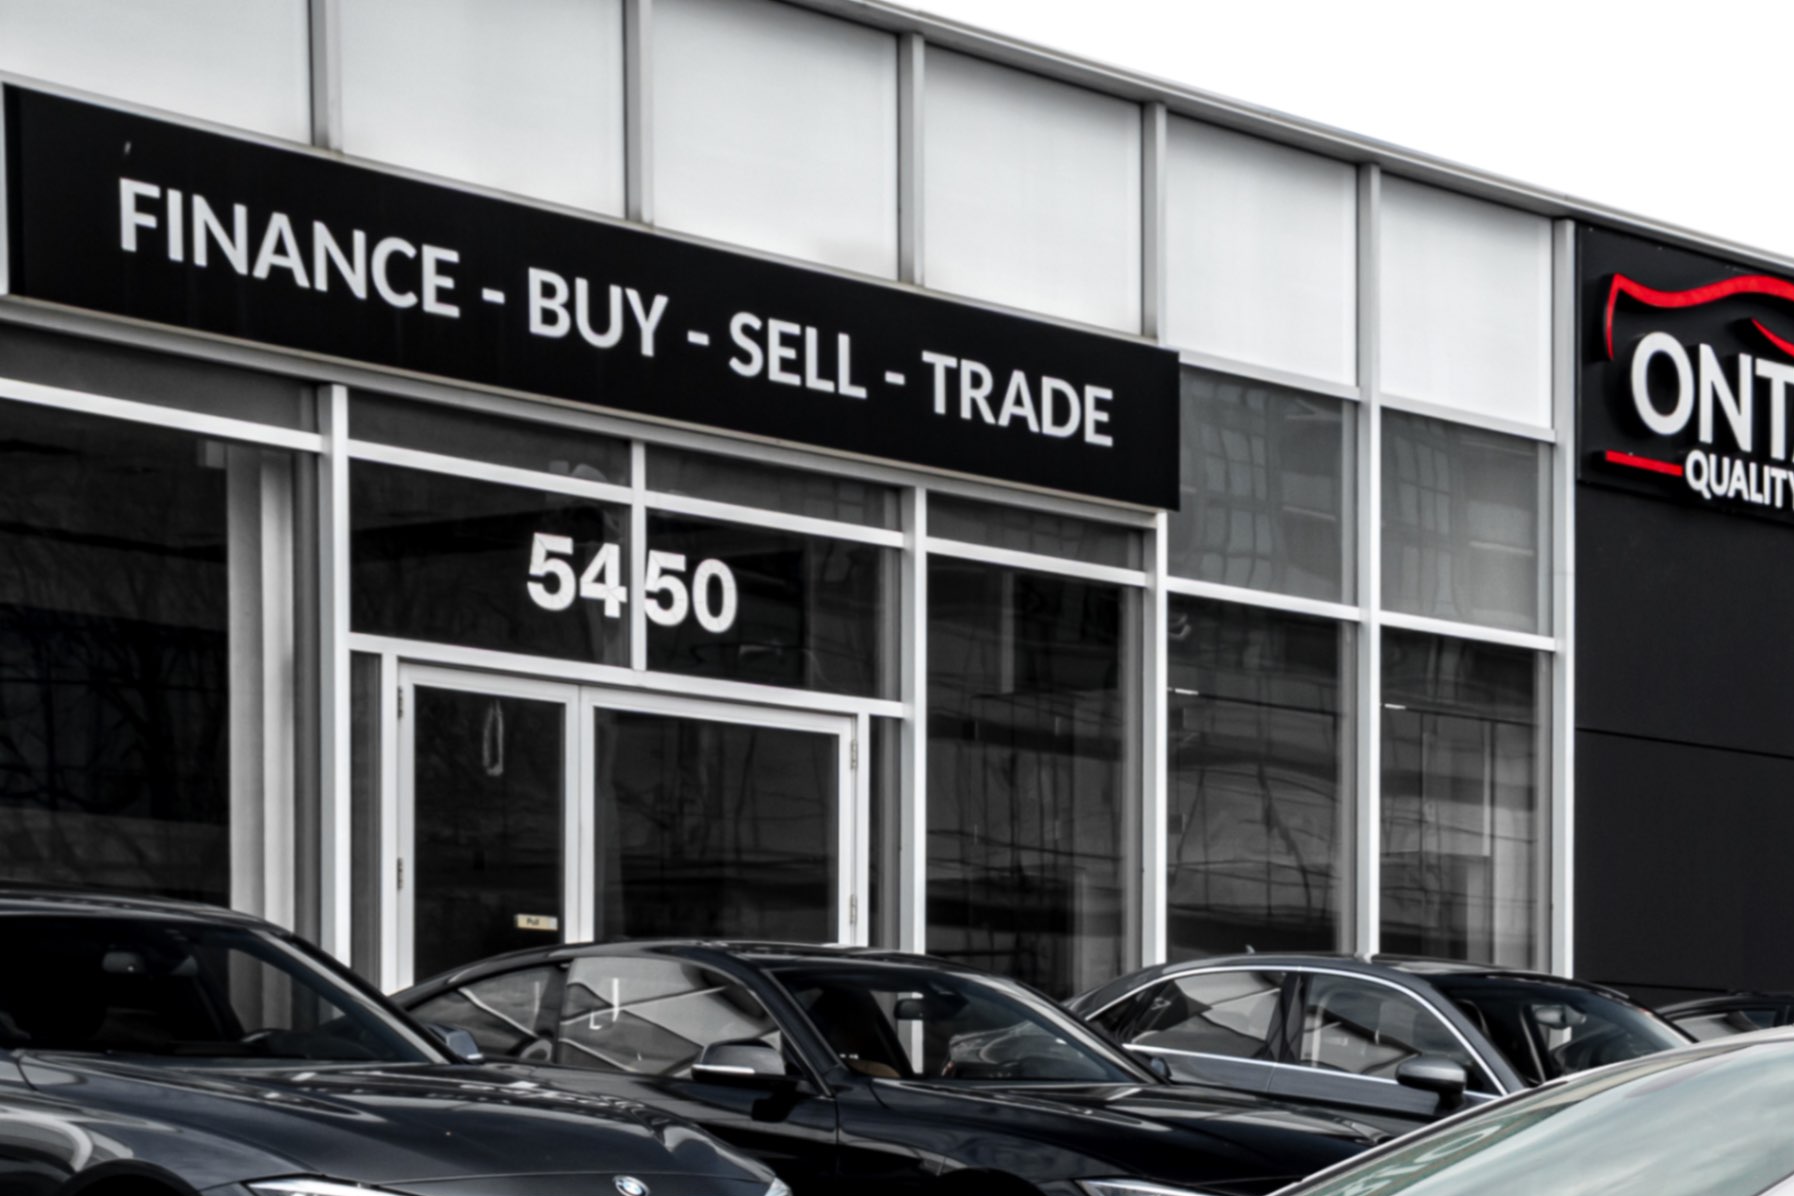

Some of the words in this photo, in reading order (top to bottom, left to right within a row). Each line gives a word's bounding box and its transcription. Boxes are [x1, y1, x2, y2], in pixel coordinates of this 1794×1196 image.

[119, 178, 460, 318] FINANCE
[482, 288, 505, 304] -
[528, 267, 668, 357] BUY
[687, 331, 709, 346] -
[729, 312, 867, 399] SELL
[885, 371, 905, 385] -
[922, 350, 1113, 447] TRADE
[527, 532, 739, 634] 5450
